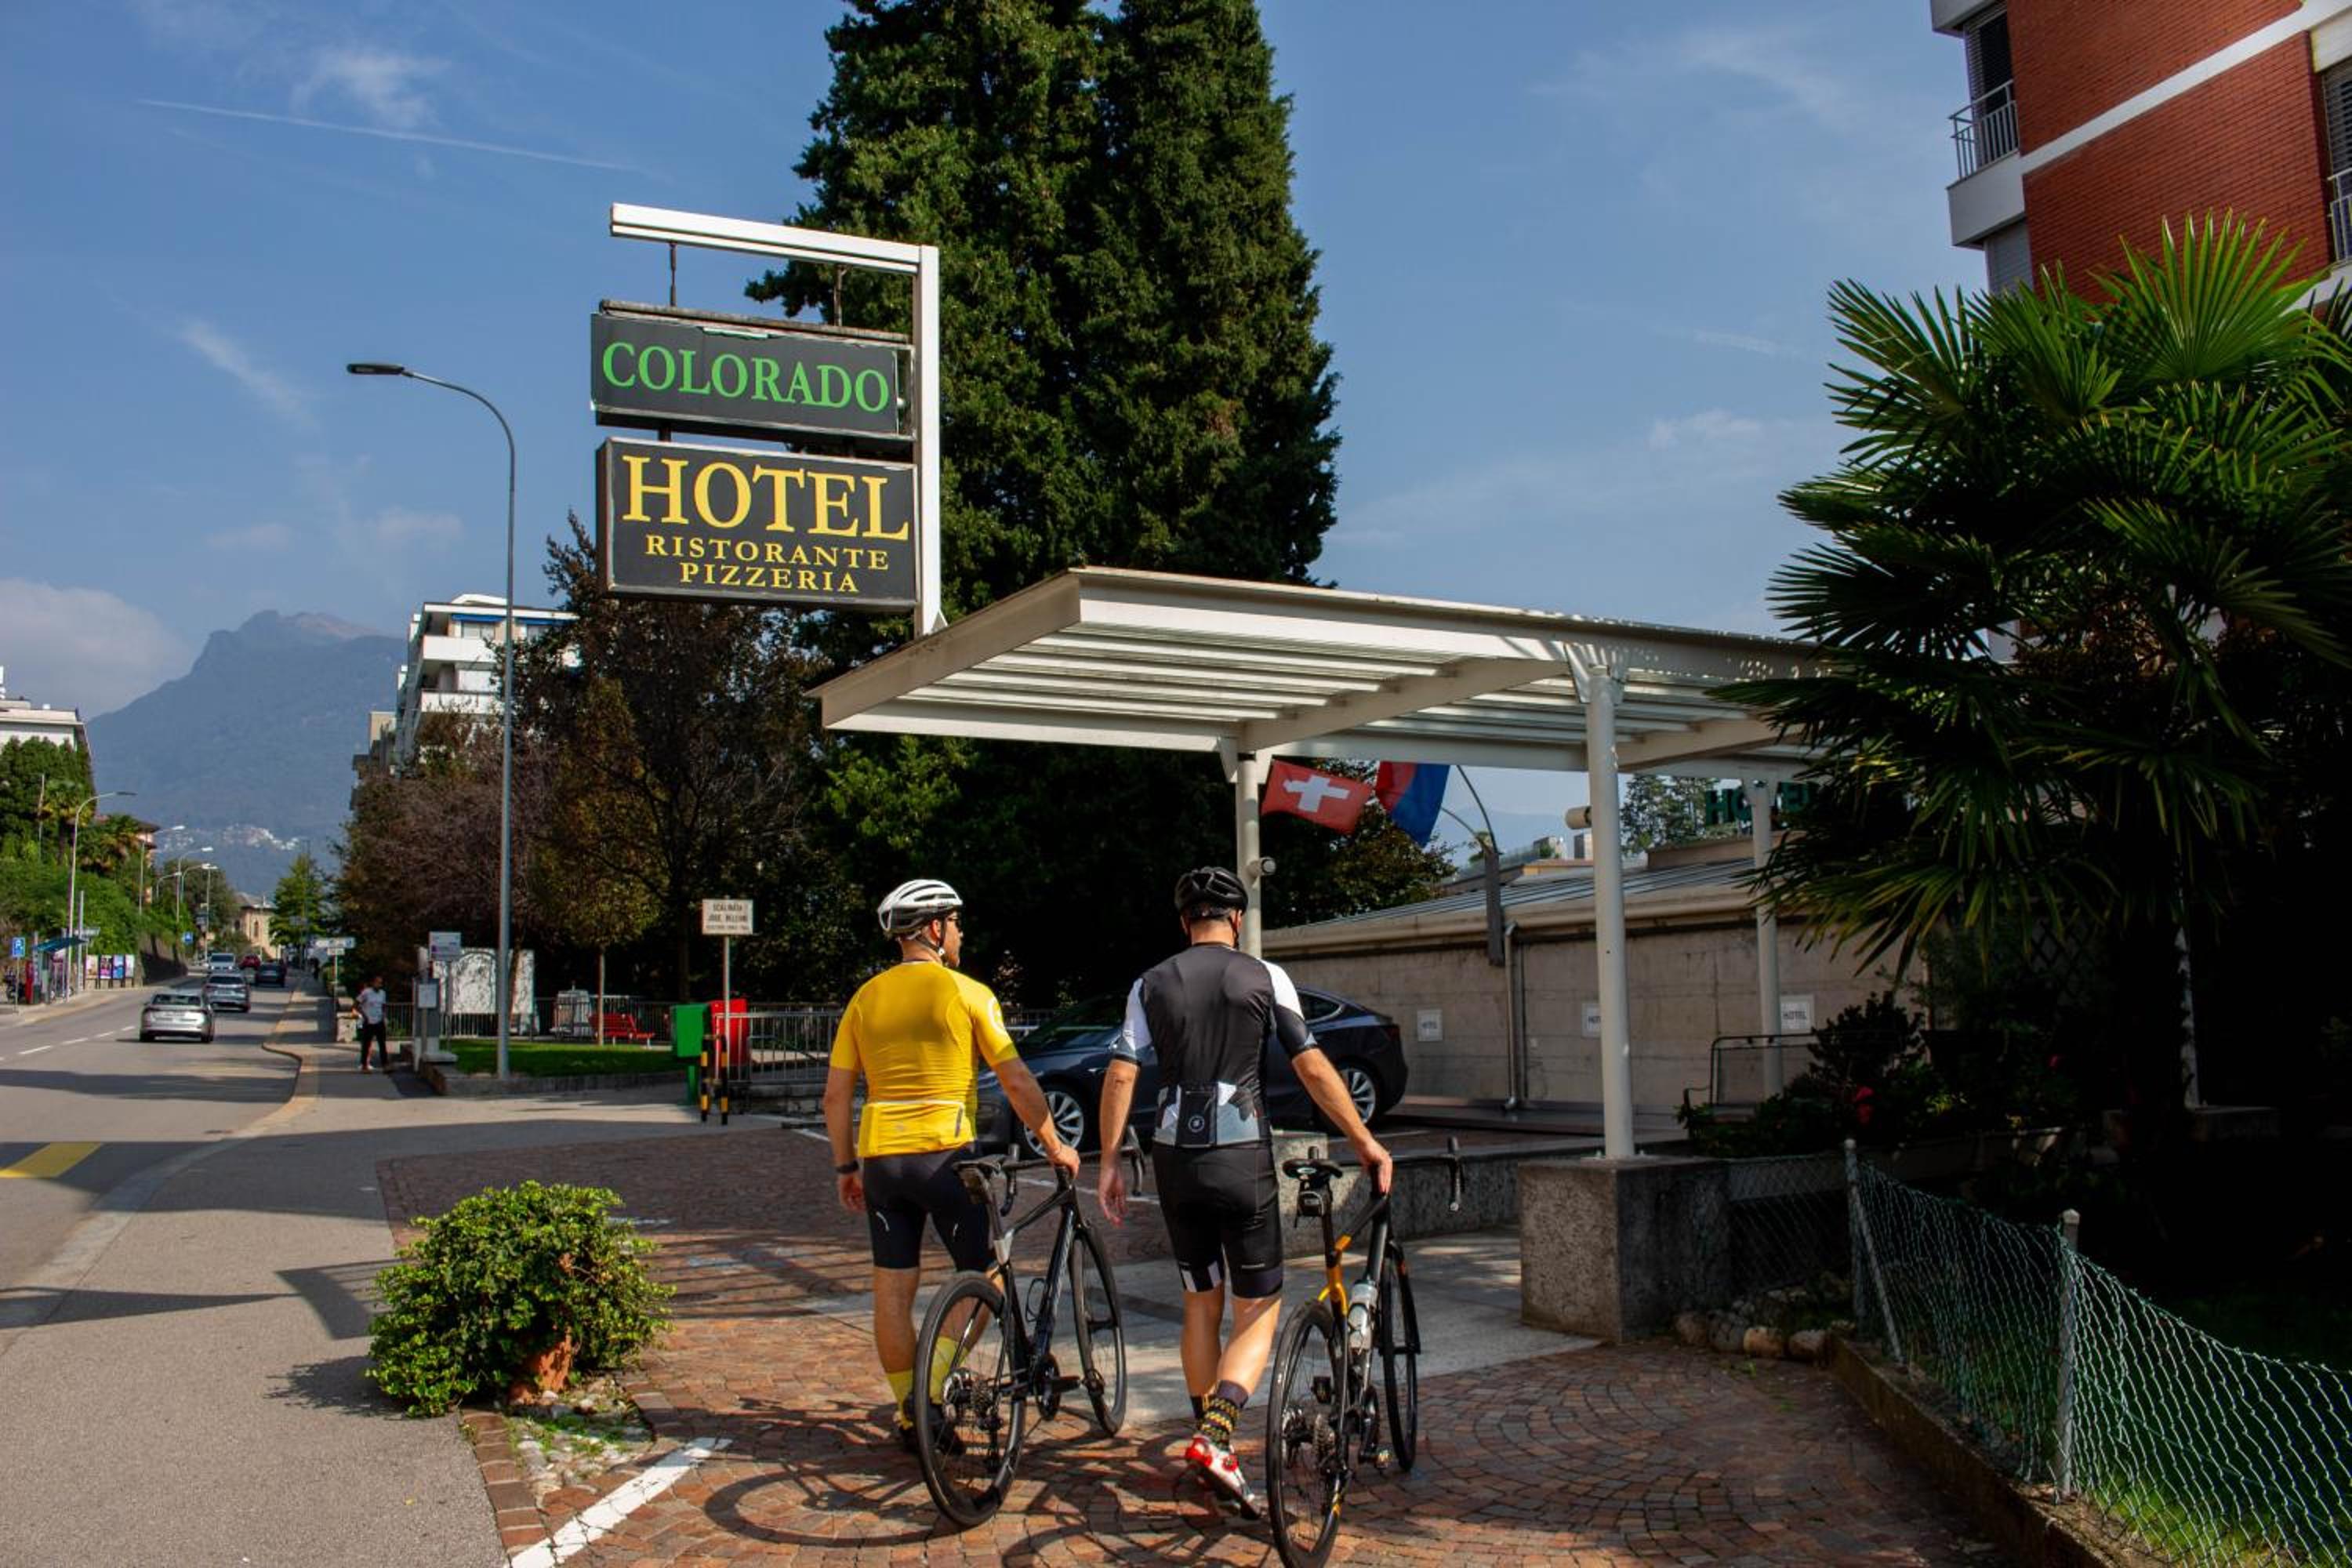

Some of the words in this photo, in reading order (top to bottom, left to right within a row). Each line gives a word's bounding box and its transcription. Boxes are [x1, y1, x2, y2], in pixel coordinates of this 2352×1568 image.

[602, 342, 890, 412] COLORADO
[622, 454, 909, 541] HOTEL
[645, 533, 890, 572] RISTORANTE
[679, 561, 859, 593] PIZZERIA
[1705, 779, 1817, 827] HOE
